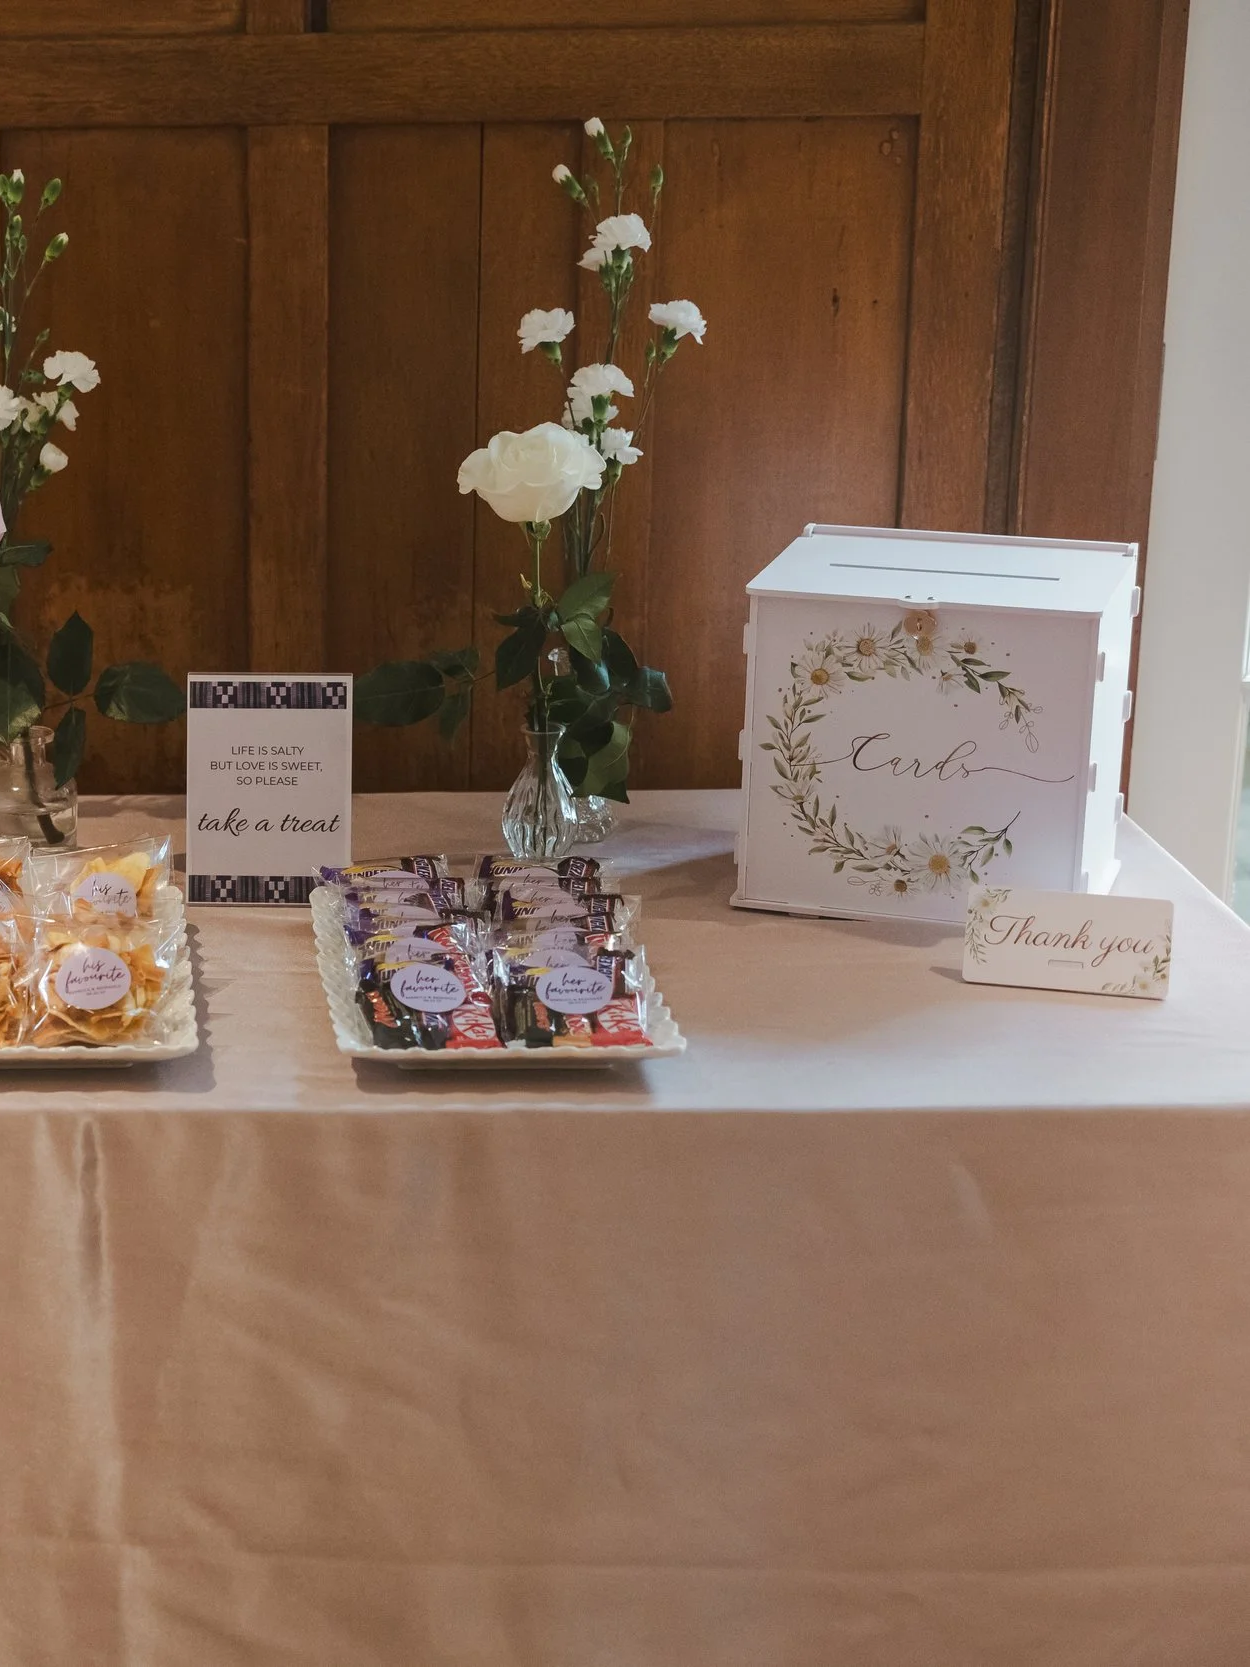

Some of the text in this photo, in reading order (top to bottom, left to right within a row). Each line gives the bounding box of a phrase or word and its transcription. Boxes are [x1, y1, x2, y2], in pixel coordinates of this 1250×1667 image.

[231, 746, 304, 756] LIFE IS SALTY
[210, 761, 323, 772] BUT LOVE IS SWEET,
[236, 776, 298, 786] SO PLEASE
[197, 807, 341, 837] take a treat
[91, 880, 112, 897] his
[984, 915, 1154, 968] Thank you
[83, 958, 105, 973] his
[65, 966, 125, 993] favourite
[416, 970, 440, 984] her
[561, 973, 586, 985] her
[401, 980, 459, 997] favourite
[545, 982, 606, 1000] favourite
